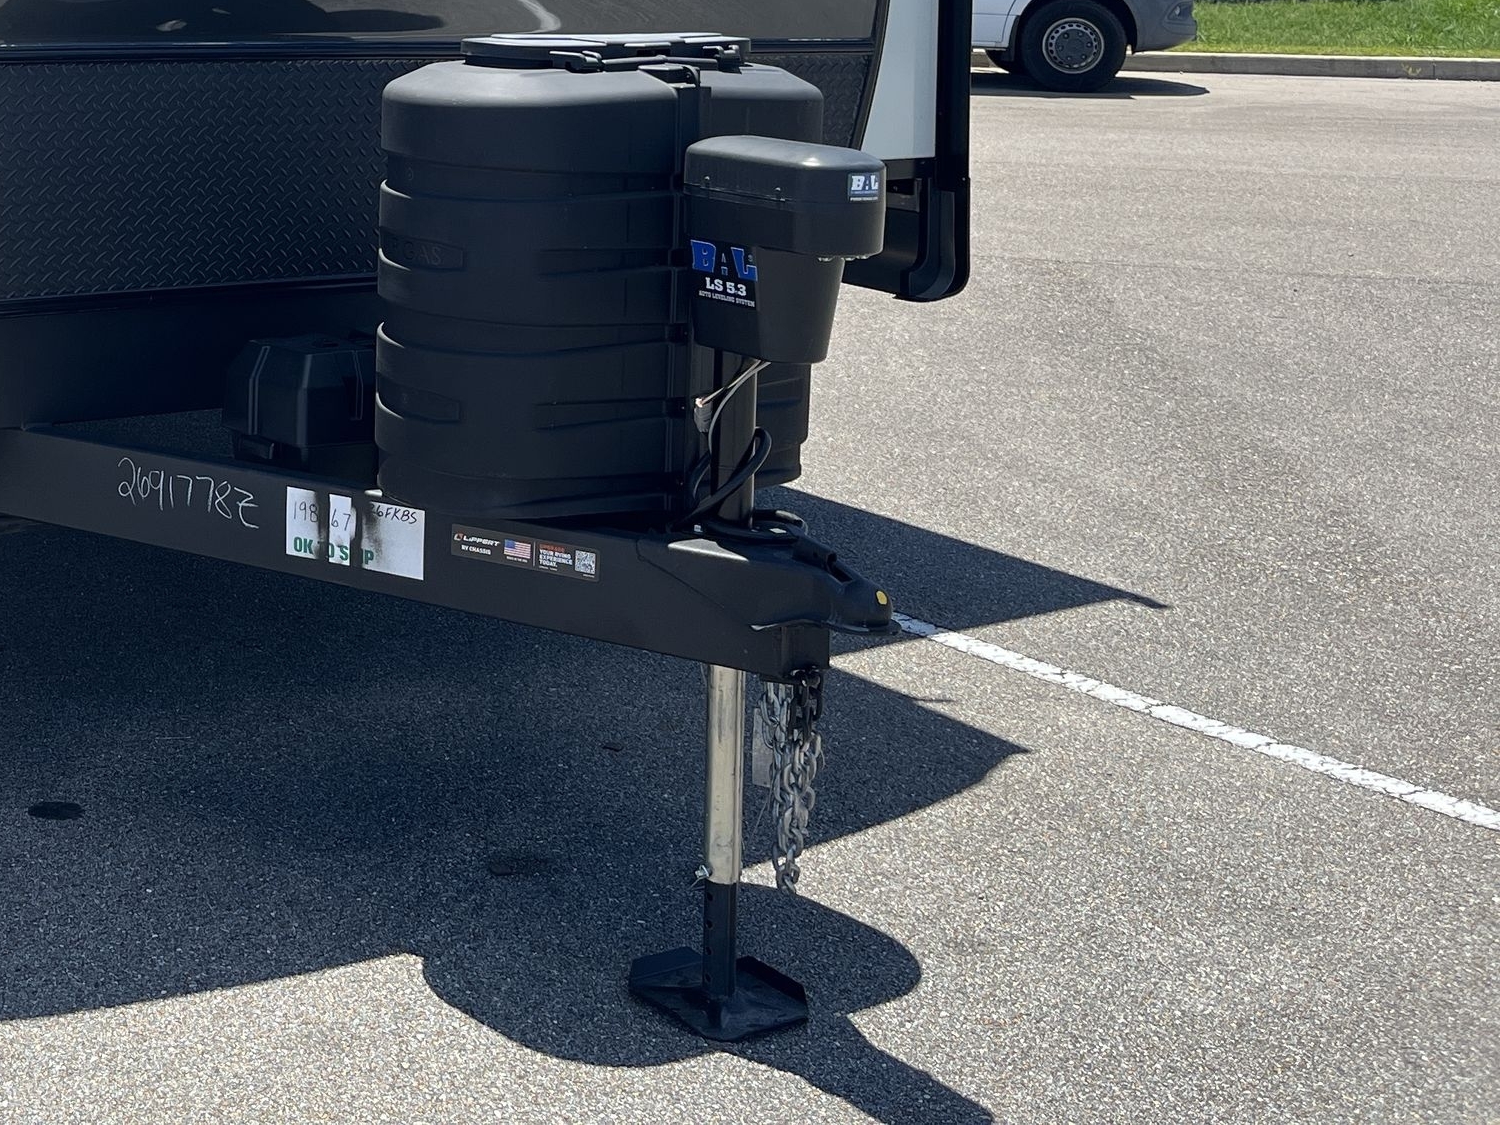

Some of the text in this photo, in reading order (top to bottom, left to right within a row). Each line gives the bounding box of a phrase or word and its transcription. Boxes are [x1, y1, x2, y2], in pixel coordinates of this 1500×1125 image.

[690, 239, 758, 282] BAL
[705, 276, 747, 297] LS 5.3
[711, 292, 736, 304] LEVELING
[735, 297, 756, 308] SYSTEM
[293, 536, 314, 555] OK
[469, 545, 492, 556] CHASSIS
